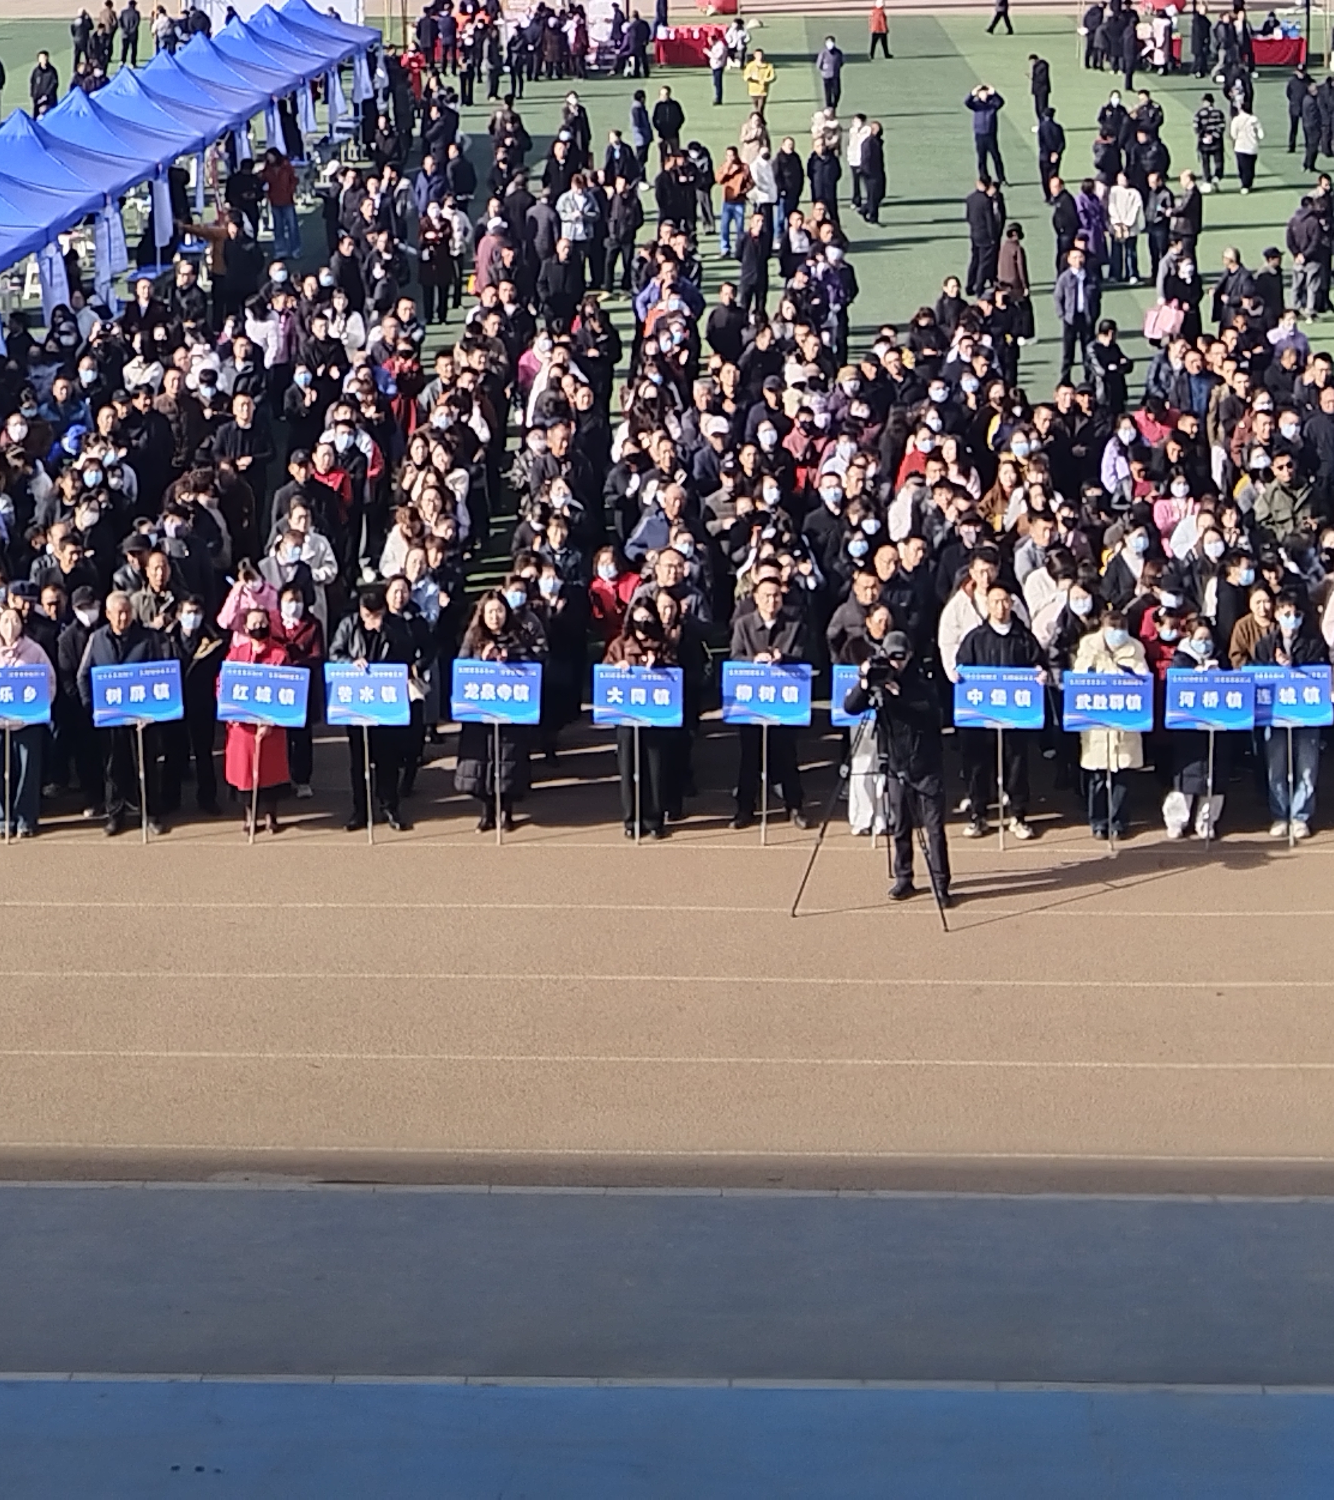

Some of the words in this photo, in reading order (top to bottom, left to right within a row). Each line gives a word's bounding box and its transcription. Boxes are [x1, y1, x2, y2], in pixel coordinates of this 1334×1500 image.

[105, 683, 170, 706] 树屏镇
[232, 684, 295, 705] 红城镇
[337, 686, 397, 703] 苦水镇
[463, 682, 530, 702] 龙泉寺镇
[606, 687, 670, 706] 大同镇
[966, 688, 1031, 707] 中堡镇
[1179, 690, 1242, 708] 河桥镇
